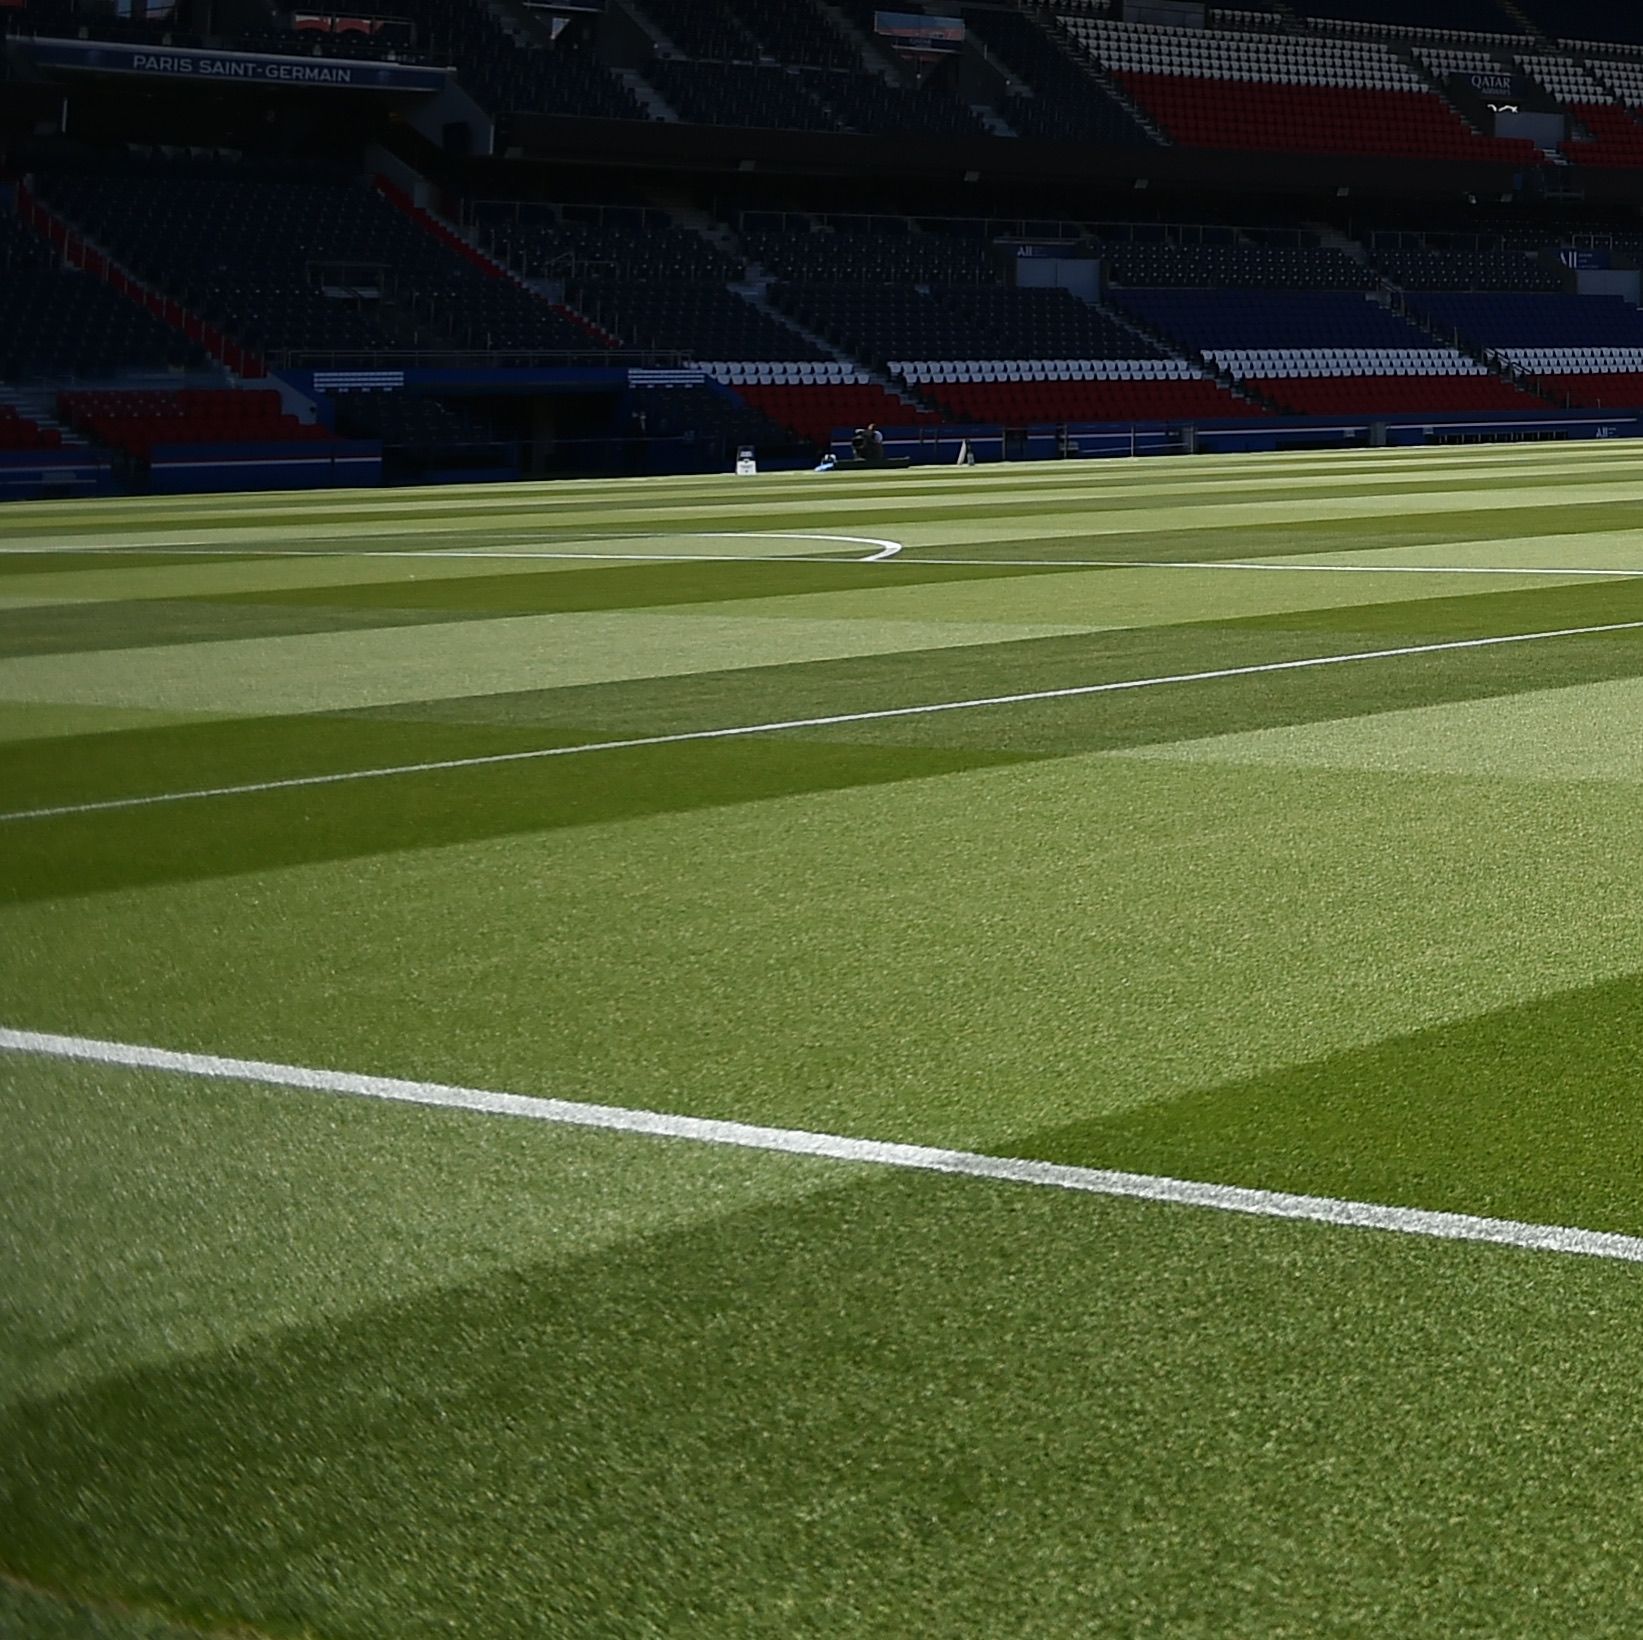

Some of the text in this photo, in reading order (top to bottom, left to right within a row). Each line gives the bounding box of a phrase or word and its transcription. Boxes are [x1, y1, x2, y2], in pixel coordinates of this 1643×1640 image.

[133, 54, 351, 85] PARIS SAINT-GERMAIN
[1471, 75, 1511, 90] QATAR
